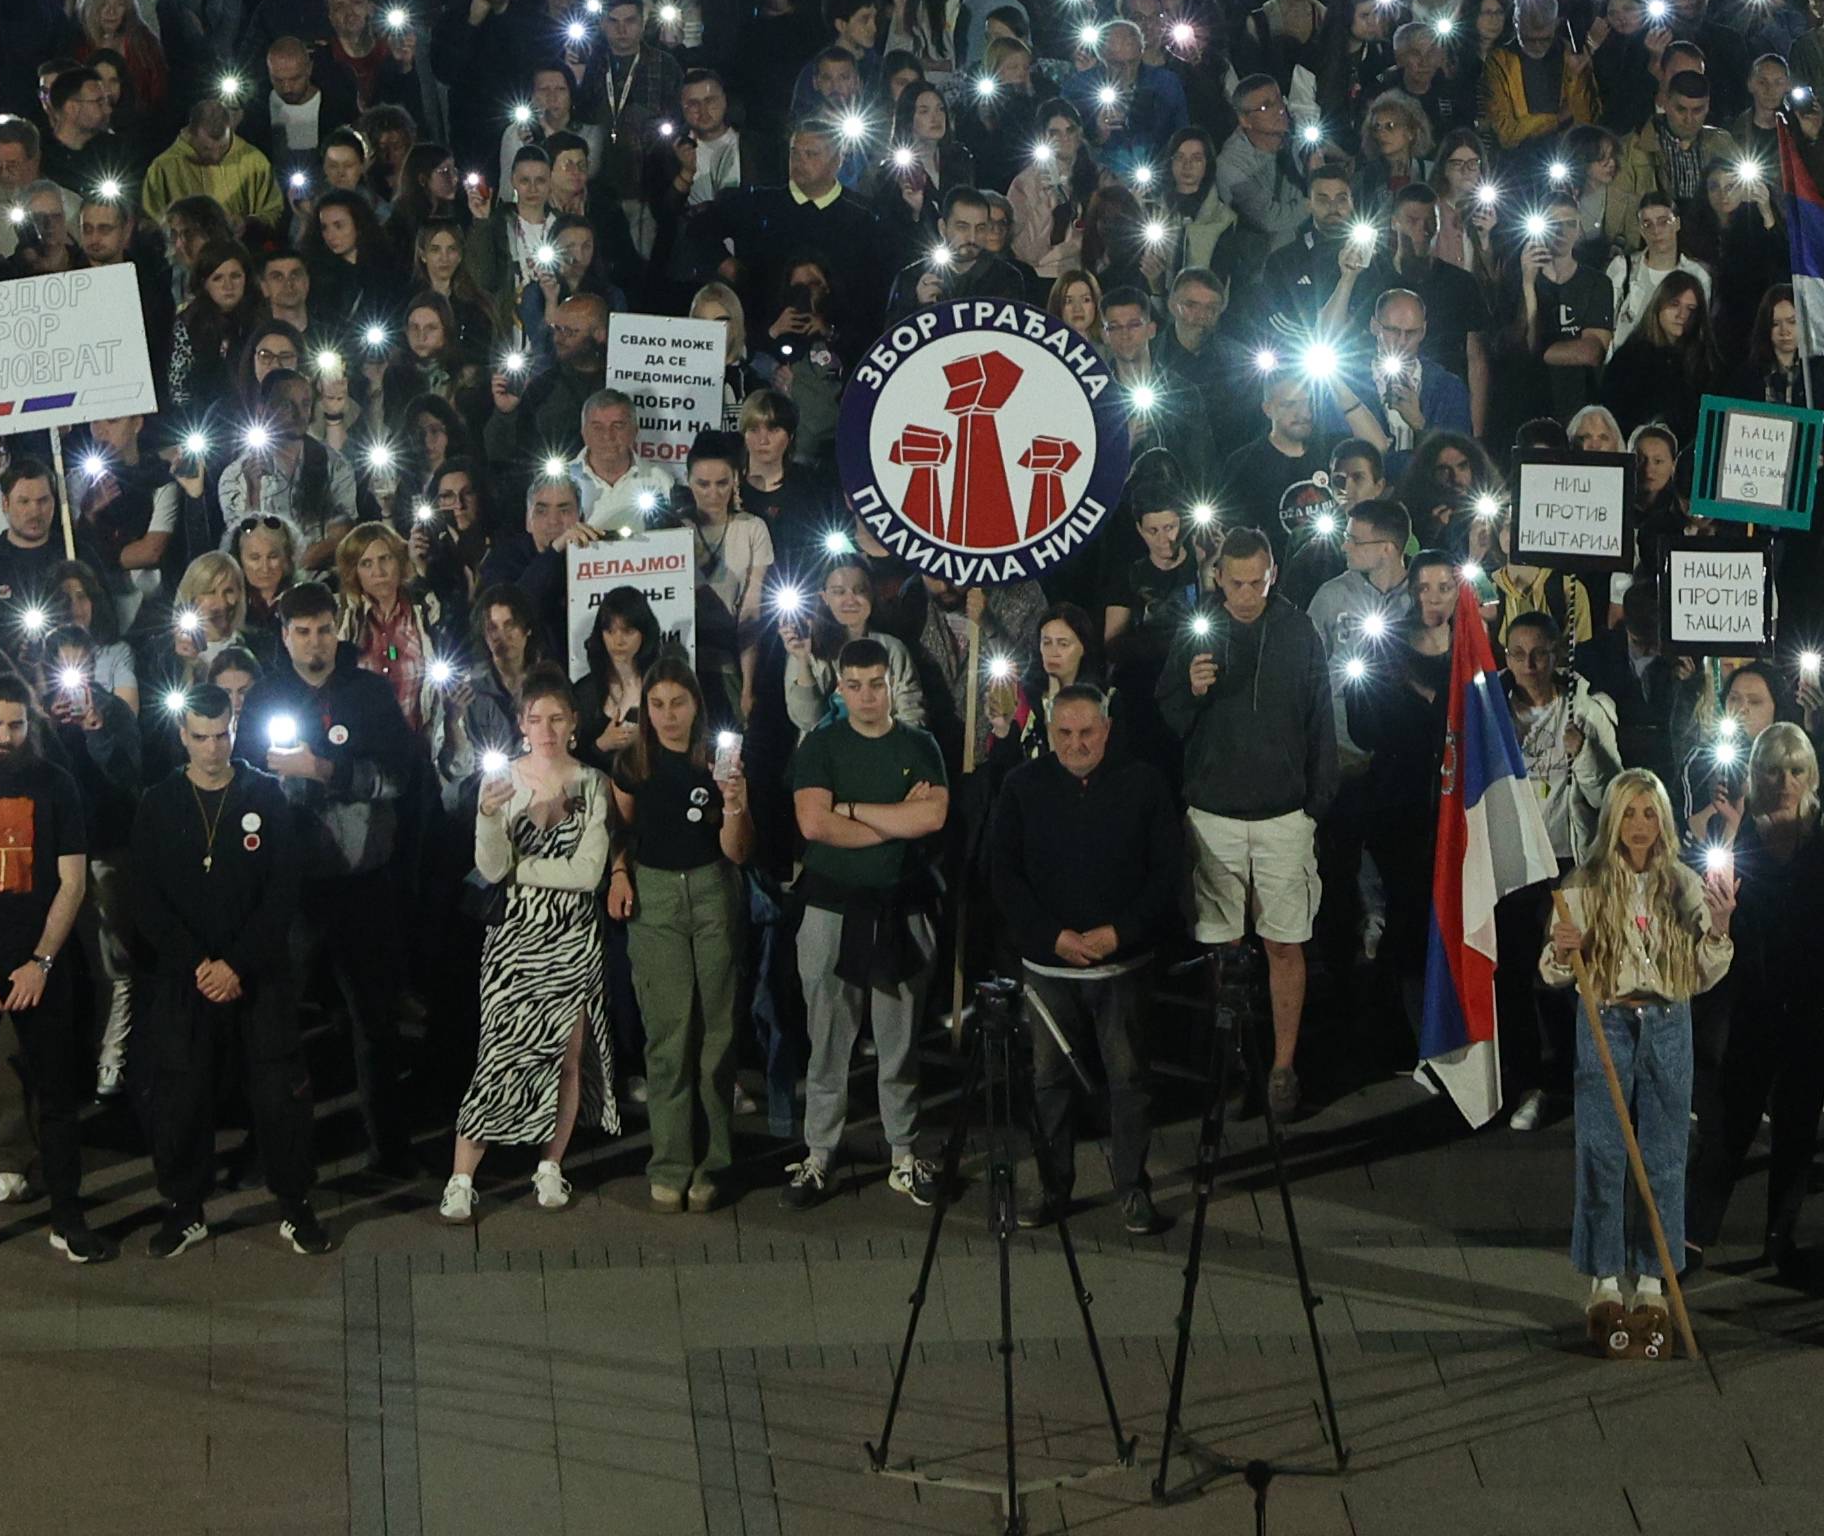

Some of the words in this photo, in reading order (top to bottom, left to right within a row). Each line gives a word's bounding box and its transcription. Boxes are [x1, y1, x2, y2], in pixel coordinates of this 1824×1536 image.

[620, 334, 667, 347] СВАКО
[671, 338, 714, 351] МОЖЕ
[857, 312, 938, 390] ЗБОР
[952, 302, 1110, 400] ГРАЂАНА
[645, 354, 664, 365] ДА
[669, 356, 687, 366] СЕ
[614, 369, 716, 387] ПРЕДОМИСЛИ.
[633, 395, 696, 410] ДОБРО
[688, 421, 712, 432] НА
[1734, 446, 1775, 461] НИСИ
[1554, 476, 1591, 493] НИШ
[1535, 503, 1607, 522] ПРОТИВ
[852, 485, 1026, 586] ПАЛИЛУЛА
[1029, 496, 1107, 570] НИШ
[1520, 529, 1620, 551] НИШТАРИЈА
[577, 554, 686, 581] ДЕЛАЈМО!
[1683, 561, 1752, 580] НАЦИЈА
[1678, 587, 1758, 607] ПРОТИВ
[1684, 613, 1752, 633] ЋАЦИЈА
